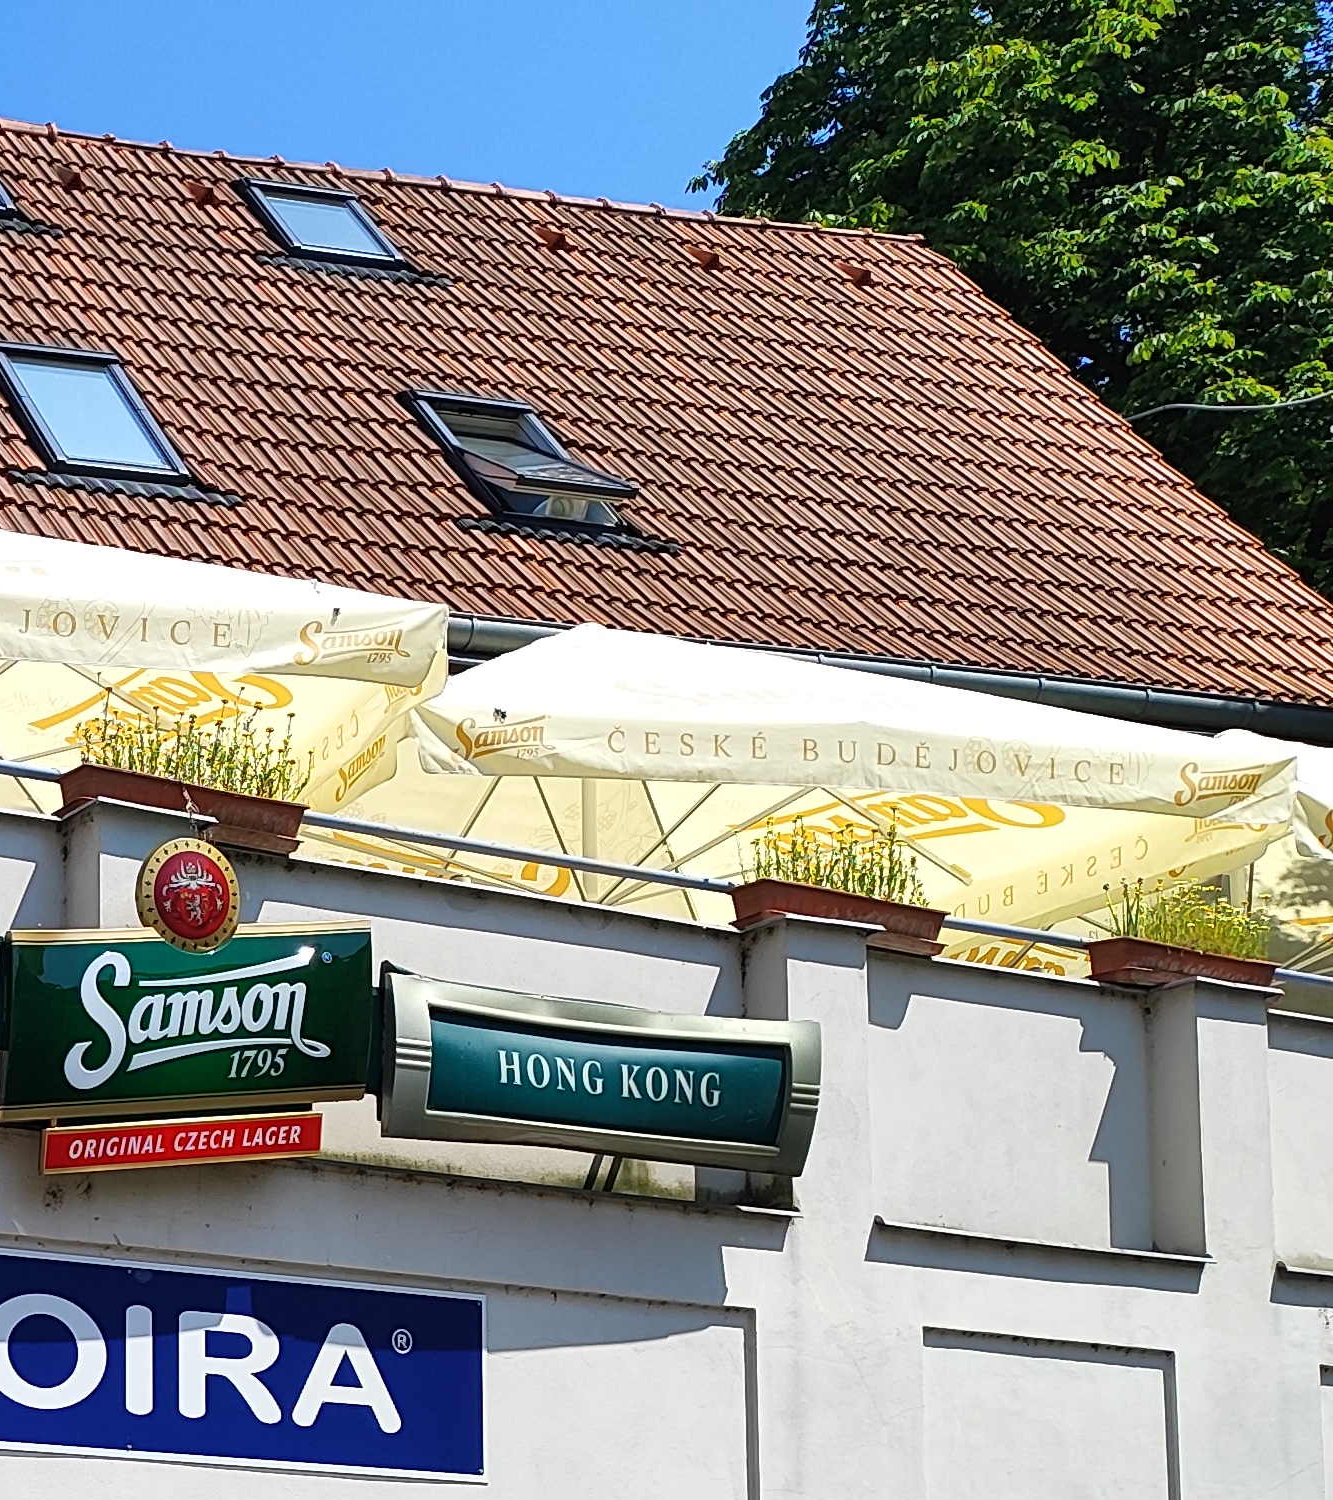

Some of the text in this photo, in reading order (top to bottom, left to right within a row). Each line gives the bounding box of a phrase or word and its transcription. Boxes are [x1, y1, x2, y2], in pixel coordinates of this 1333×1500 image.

[293, 619, 411, 666] Samson
[366, 652, 393, 665] 1795
[456, 716, 557, 761] Samson
[515, 747, 540, 759] 1795
[606, 725, 1124, 786] ČESKÉ BUDĚJOVICE
[1173, 761, 1263, 807] Samson
[64, 950, 331, 1090] Samson
[228, 1048, 289, 1079] 1795
[497, 1049, 722, 1107] HONG KONG
[68, 1125, 303, 1160] ORIGINAL CZECH LAGER
